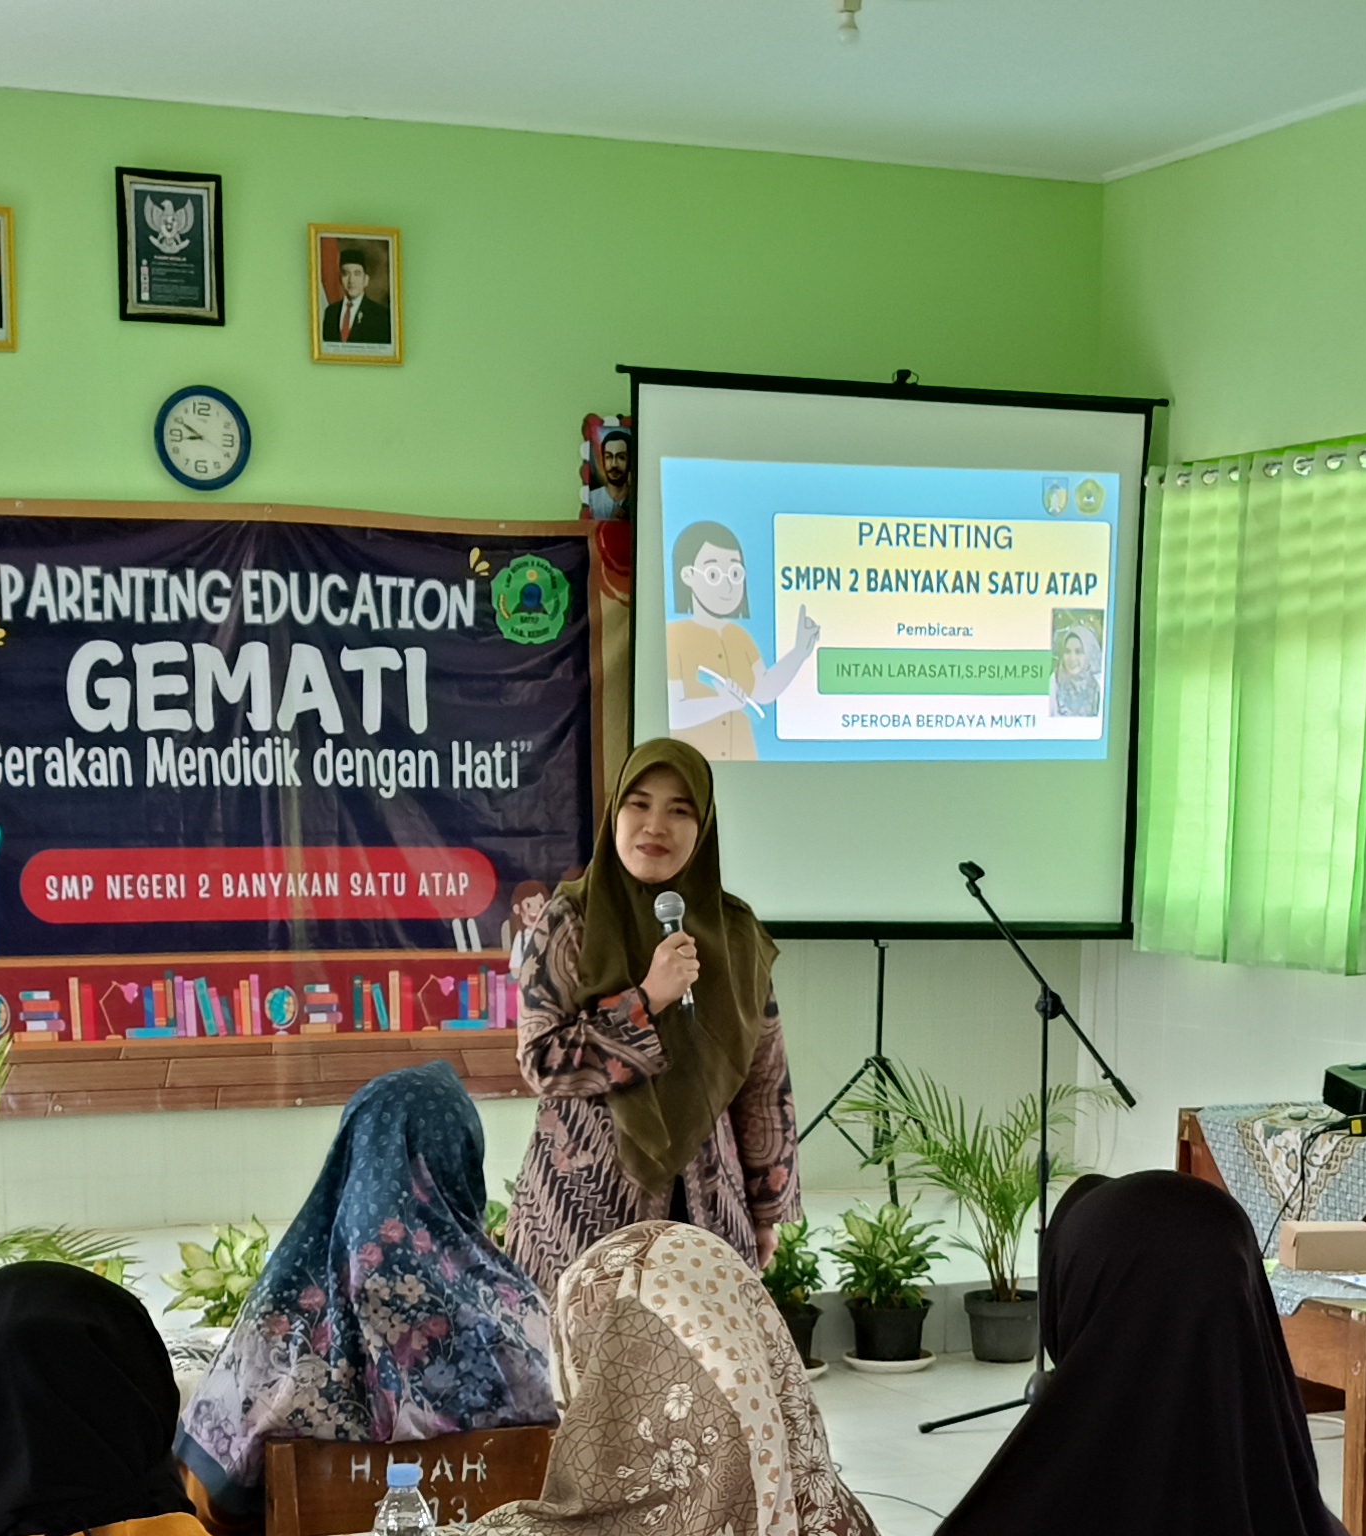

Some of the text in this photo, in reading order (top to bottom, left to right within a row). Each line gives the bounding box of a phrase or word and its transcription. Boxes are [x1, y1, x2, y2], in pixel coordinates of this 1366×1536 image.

[193, 401, 211, 416] 12
[169, 428, 183, 442] 9
[222, 433, 234, 448] 3
[195, 460, 208, 474] 6
[858, 522, 1013, 550] PARENTING
[780, 566, 1098, 596] SMPN 2 BANYAKAN SATU ATAP
[241, 568, 476, 630] EDUCATION
[897, 623, 973, 637] Pembicara:
[836, 663, 884, 679] INTAN
[66, 640, 428, 735] GEMATI
[841, 714, 1036, 729] SPEROBA BERDAYA MUKTI
[146, 736, 302, 788] Mendidik
[312, 738, 439, 798] dengan
[45, 871, 470, 900] SMP NEGERI 2 BANYAKAN SATU ATAP
